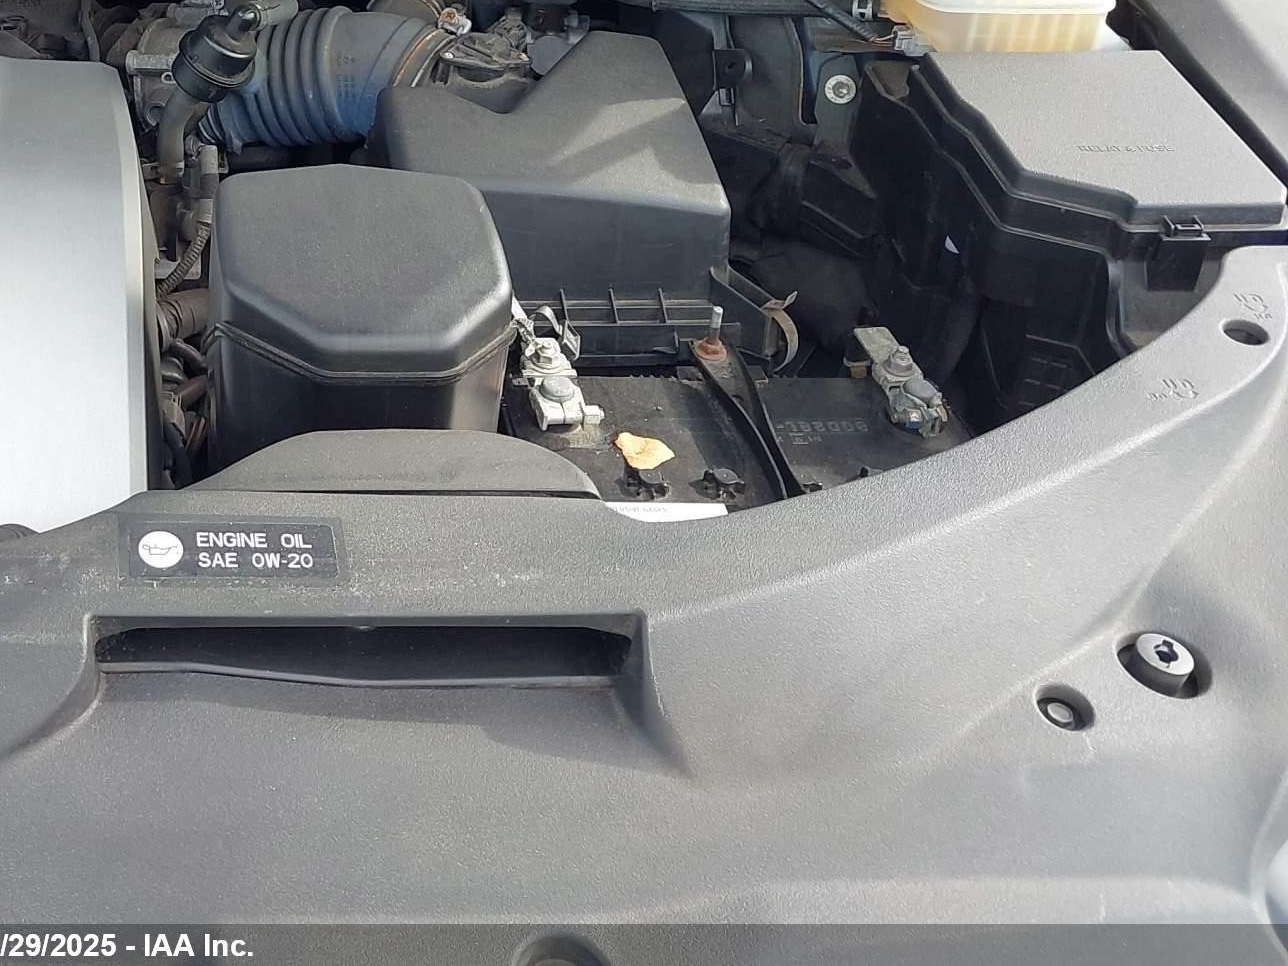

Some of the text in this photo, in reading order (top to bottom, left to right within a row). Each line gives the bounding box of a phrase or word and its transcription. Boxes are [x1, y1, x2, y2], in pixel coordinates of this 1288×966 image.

[196, 532, 313, 549] ENGINE OIL
[197, 552, 314, 569] SAE 0W-20
